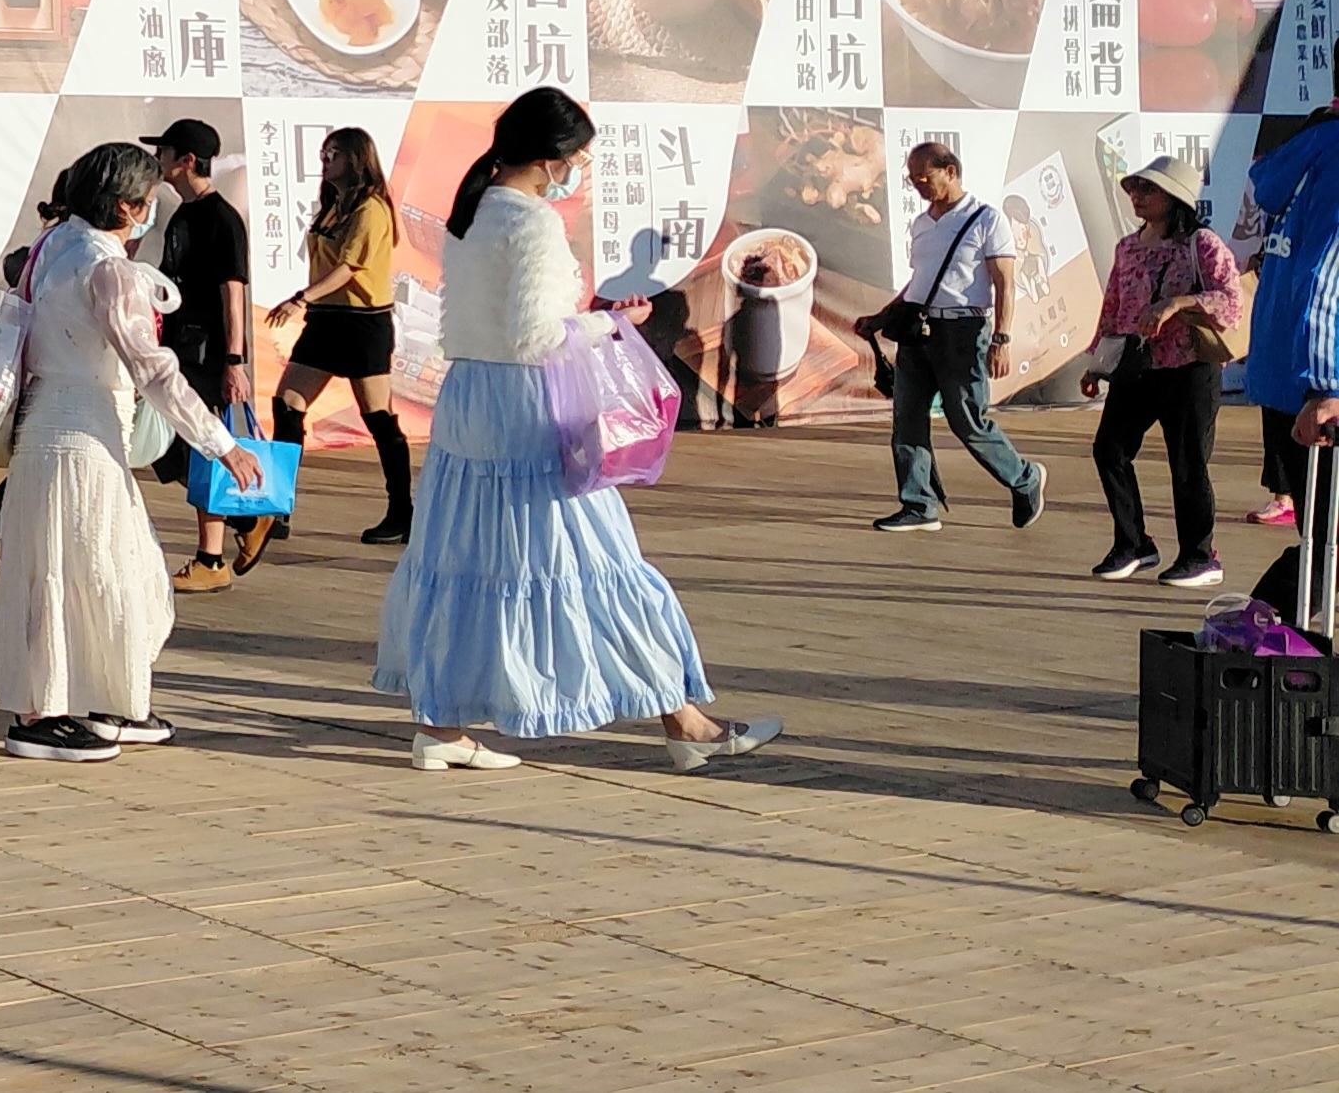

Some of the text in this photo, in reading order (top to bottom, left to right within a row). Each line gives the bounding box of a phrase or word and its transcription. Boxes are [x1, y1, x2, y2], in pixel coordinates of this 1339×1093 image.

[259, 120, 284, 269] 李記烏魚子
[598, 123, 622, 264] 雲蒸薑母鴨
[622, 124, 646, 205] 阿國師
[657, 126, 709, 260] 斗南
